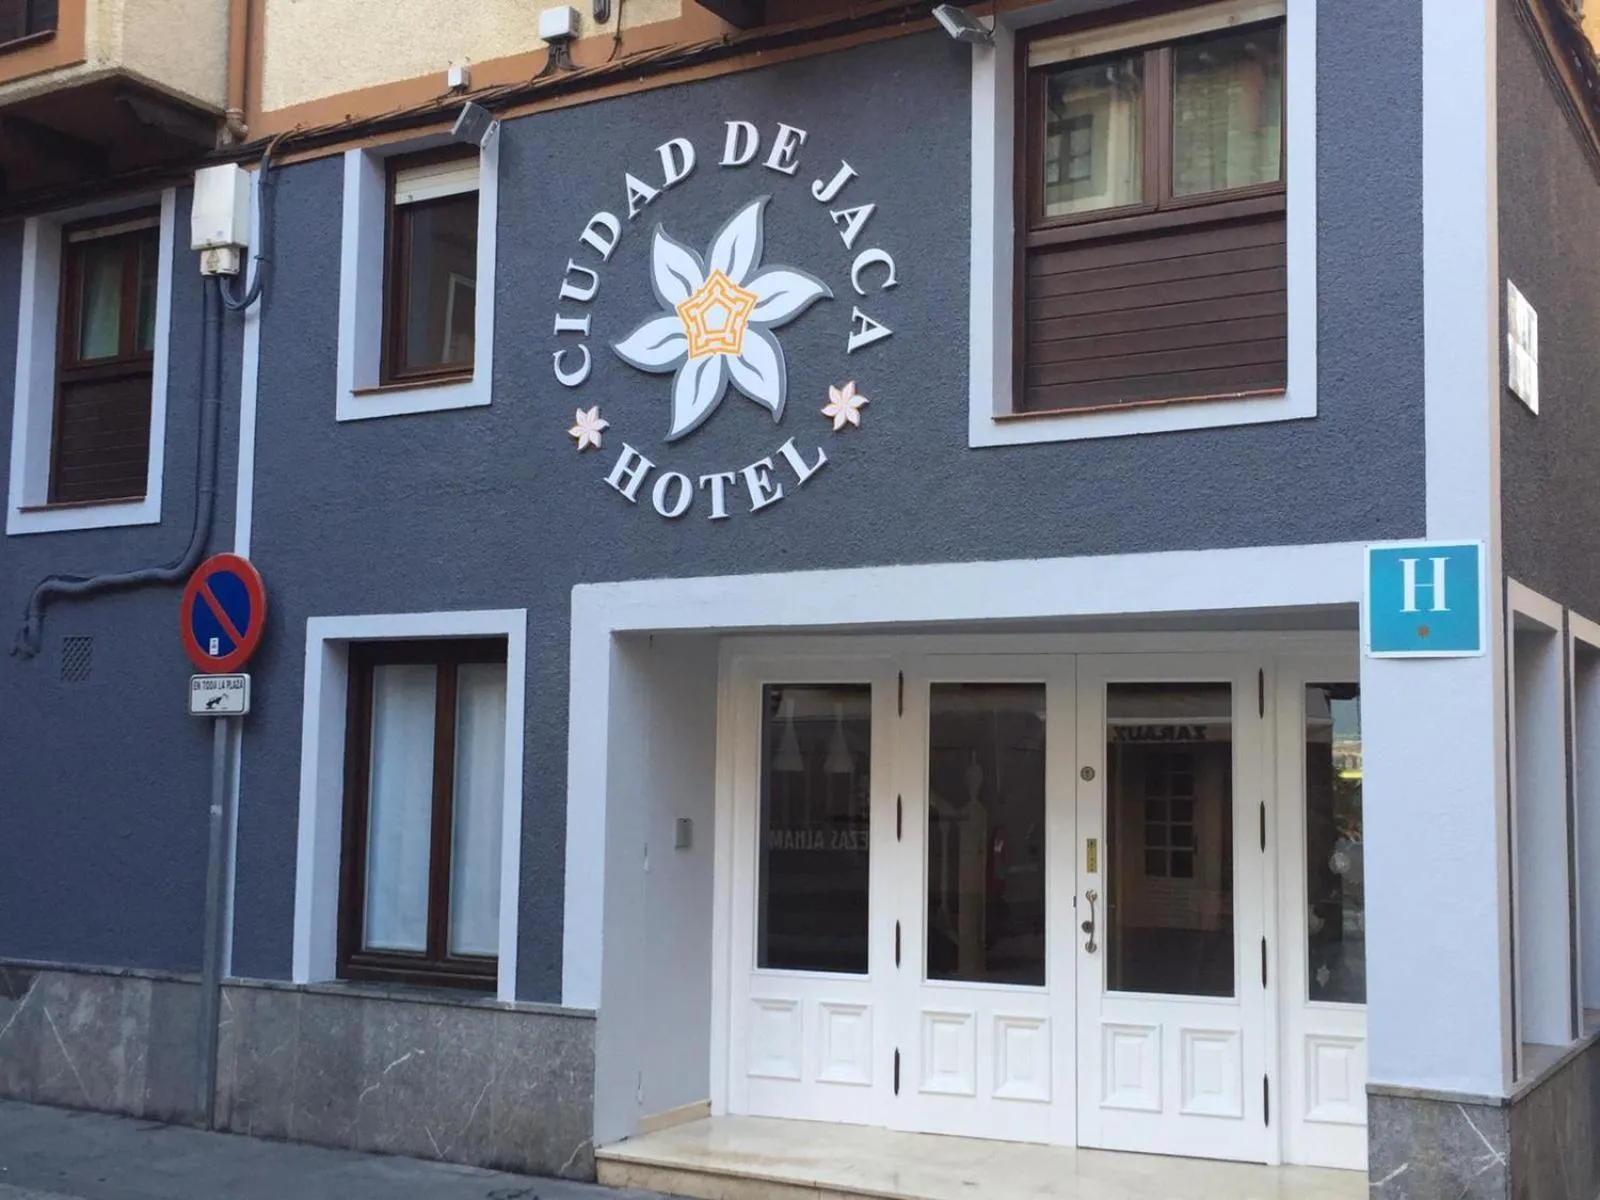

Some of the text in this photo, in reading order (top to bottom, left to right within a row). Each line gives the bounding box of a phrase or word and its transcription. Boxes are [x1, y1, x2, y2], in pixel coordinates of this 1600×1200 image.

[553, 120, 898, 387] CIUDAD DE JACA
[604, 436, 829, 519] HOTEL
[1398, 556, 1452, 612] H
